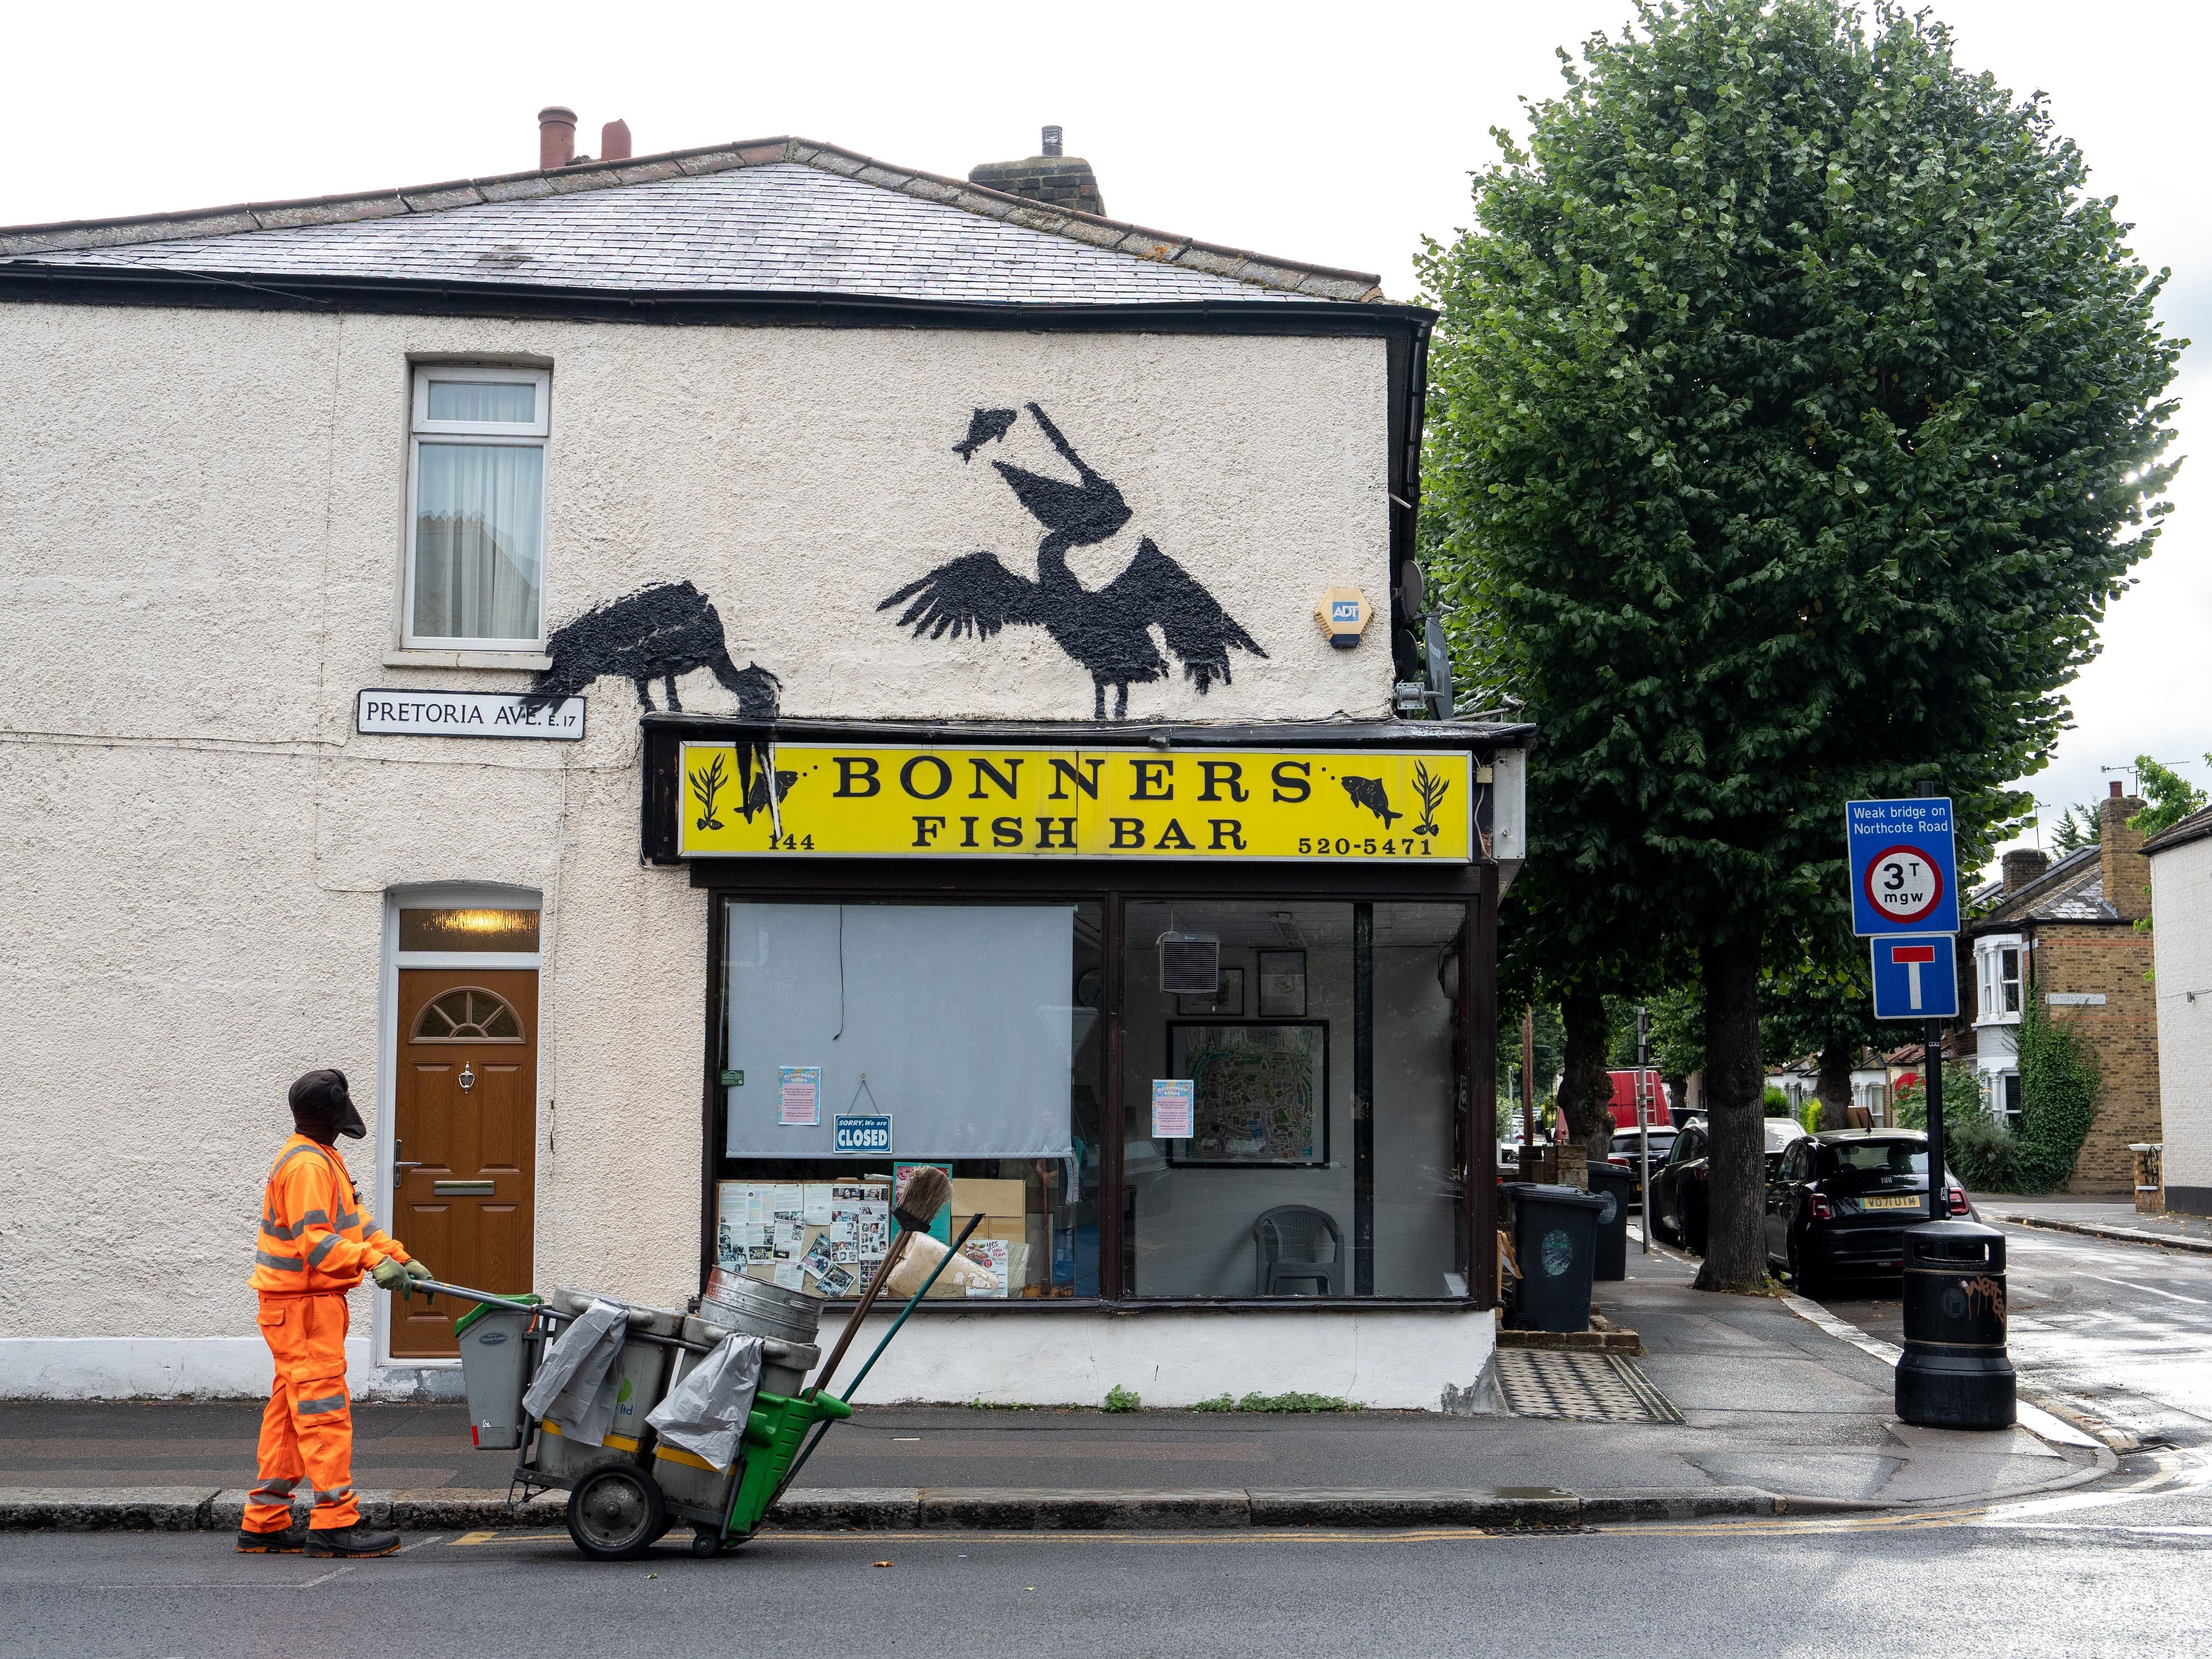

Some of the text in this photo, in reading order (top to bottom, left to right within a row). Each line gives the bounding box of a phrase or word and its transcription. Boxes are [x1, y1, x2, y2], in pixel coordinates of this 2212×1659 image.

[1333, 605, 1359, 618] ADT
[367, 702, 484, 724] PRETORIA
[564, 716, 576, 726] 17
[833, 755, 1311, 803] BONNERS
[1854, 806, 1945, 819] Weak bridge on
[912, 816, 1247, 850] FISH BAR
[1854, 820, 1948, 835] Northcote Road
[1298, 838, 1432, 855] 520-5471
[1884, 892, 1924, 905] mgw
[1186, 1030, 1313, 1054] WALTHAMSTOW
[838, 1129, 888, 1147] CLOSED
[987, 1241, 998, 1252] yes
[992, 1248, 1002, 1256] you
[620, 1403, 634, 1416] ltd
